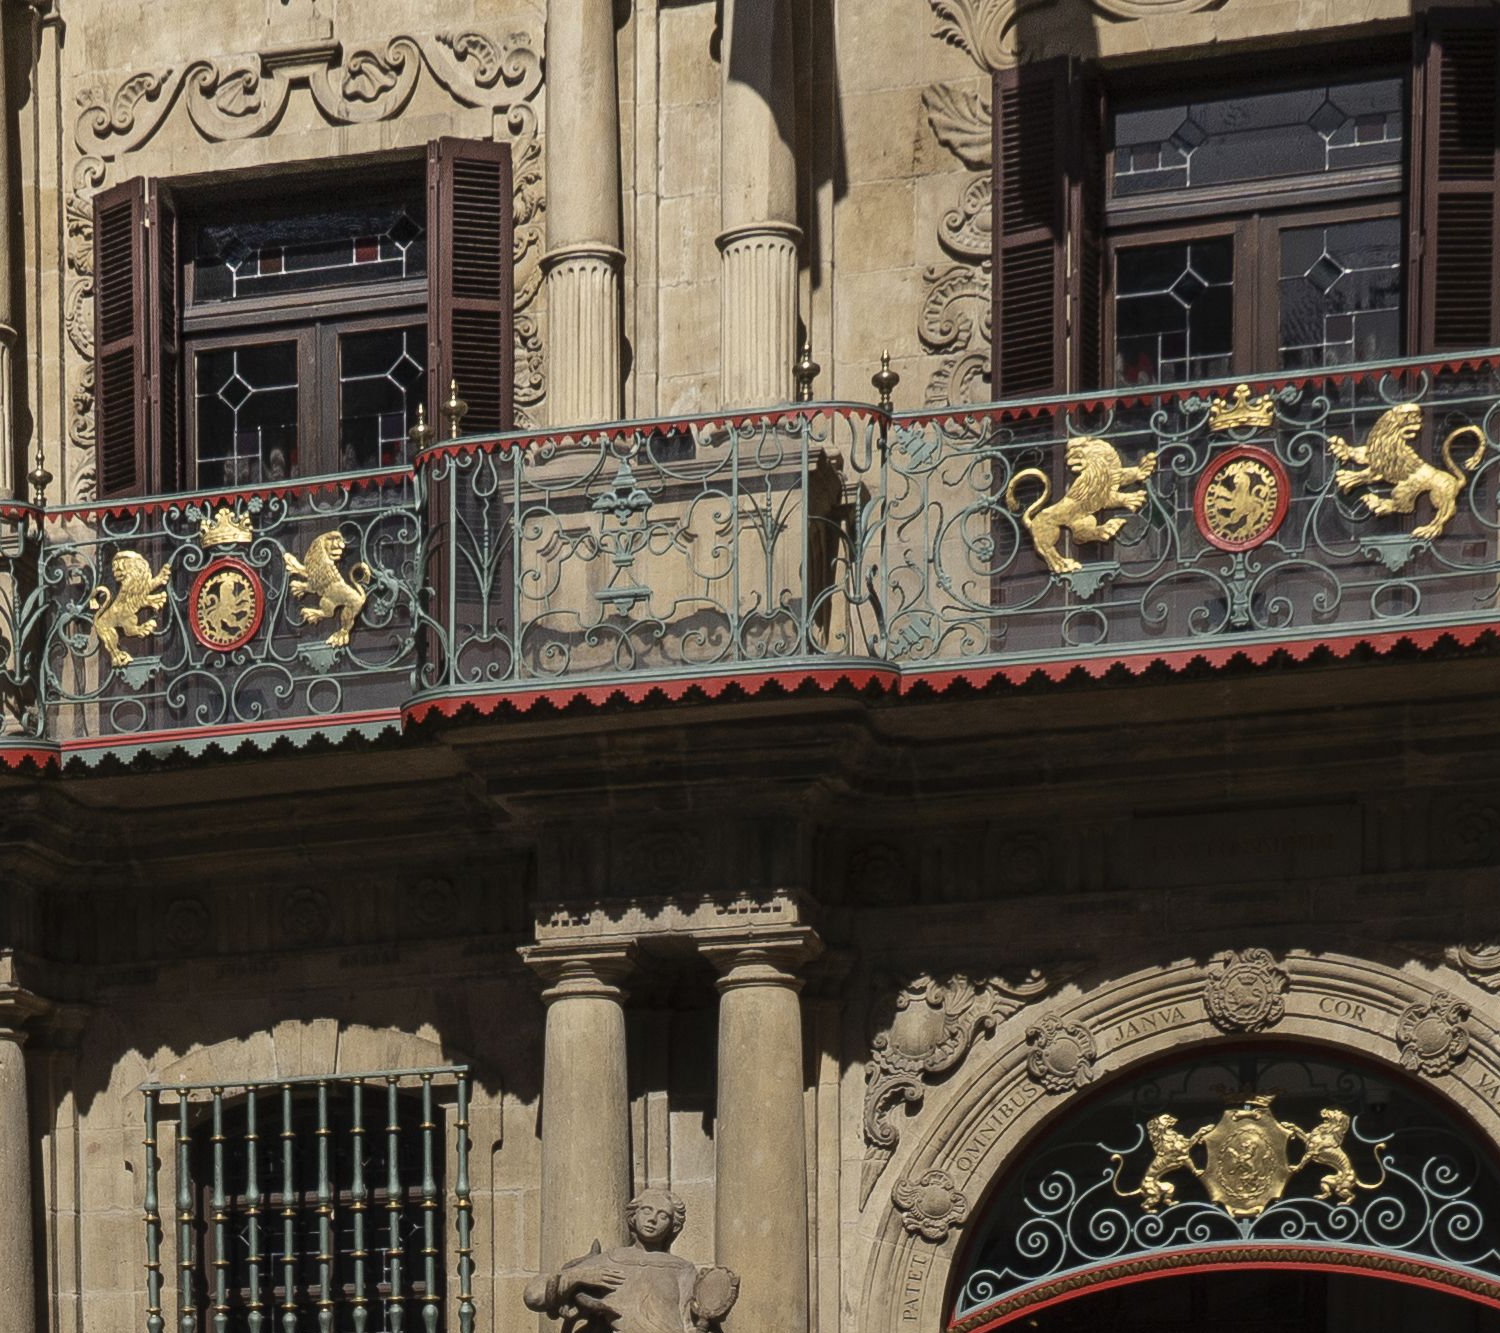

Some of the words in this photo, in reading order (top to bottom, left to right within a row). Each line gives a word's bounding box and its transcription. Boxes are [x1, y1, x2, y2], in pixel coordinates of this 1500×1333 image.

[903, 1254, 928, 1323] PATET
[956, 1083, 1038, 1172] OMNIBUS
[1114, 1006, 1187, 1042] JANVA
[1318, 996, 1367, 1023] COR
